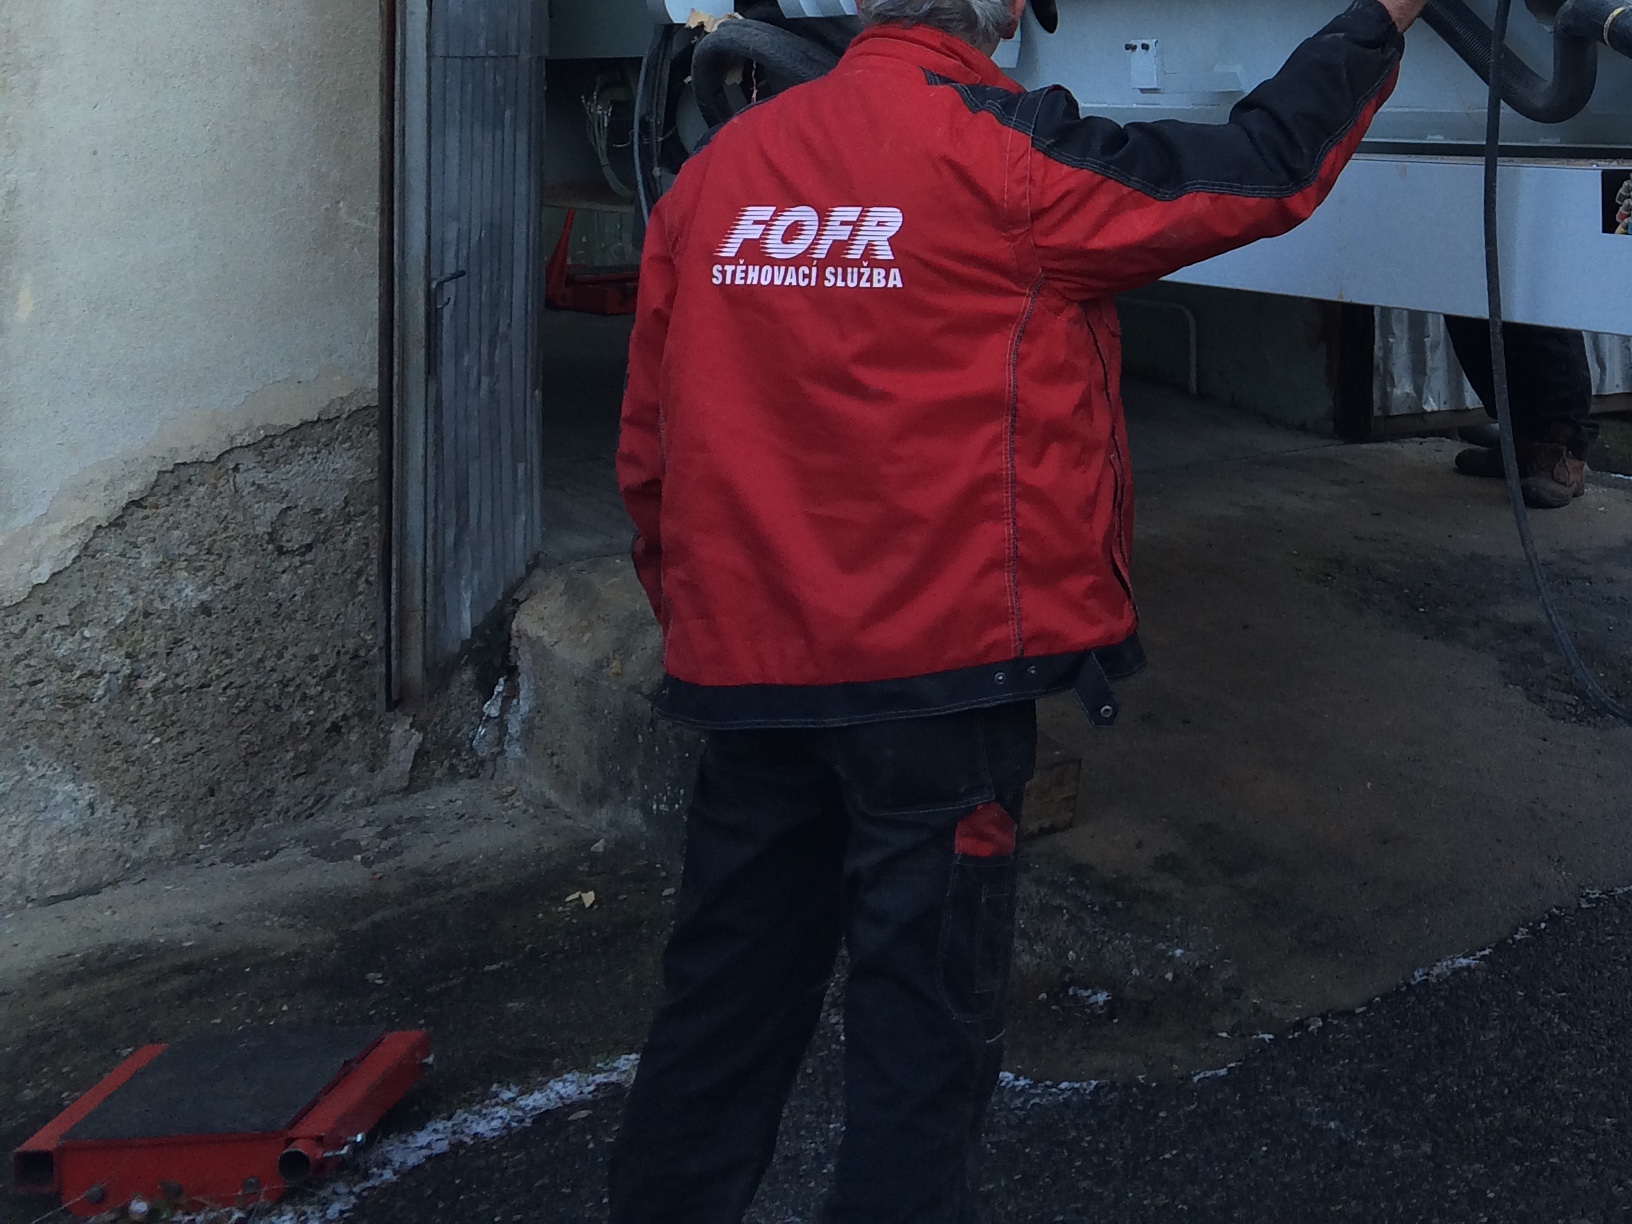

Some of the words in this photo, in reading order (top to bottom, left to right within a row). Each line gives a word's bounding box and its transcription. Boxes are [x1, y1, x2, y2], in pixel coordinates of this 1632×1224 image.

[713, 205, 904, 260] FOFR
[711, 259, 818, 286] STĚHOVACÍ
[823, 261, 904, 288] SLUŽBA
